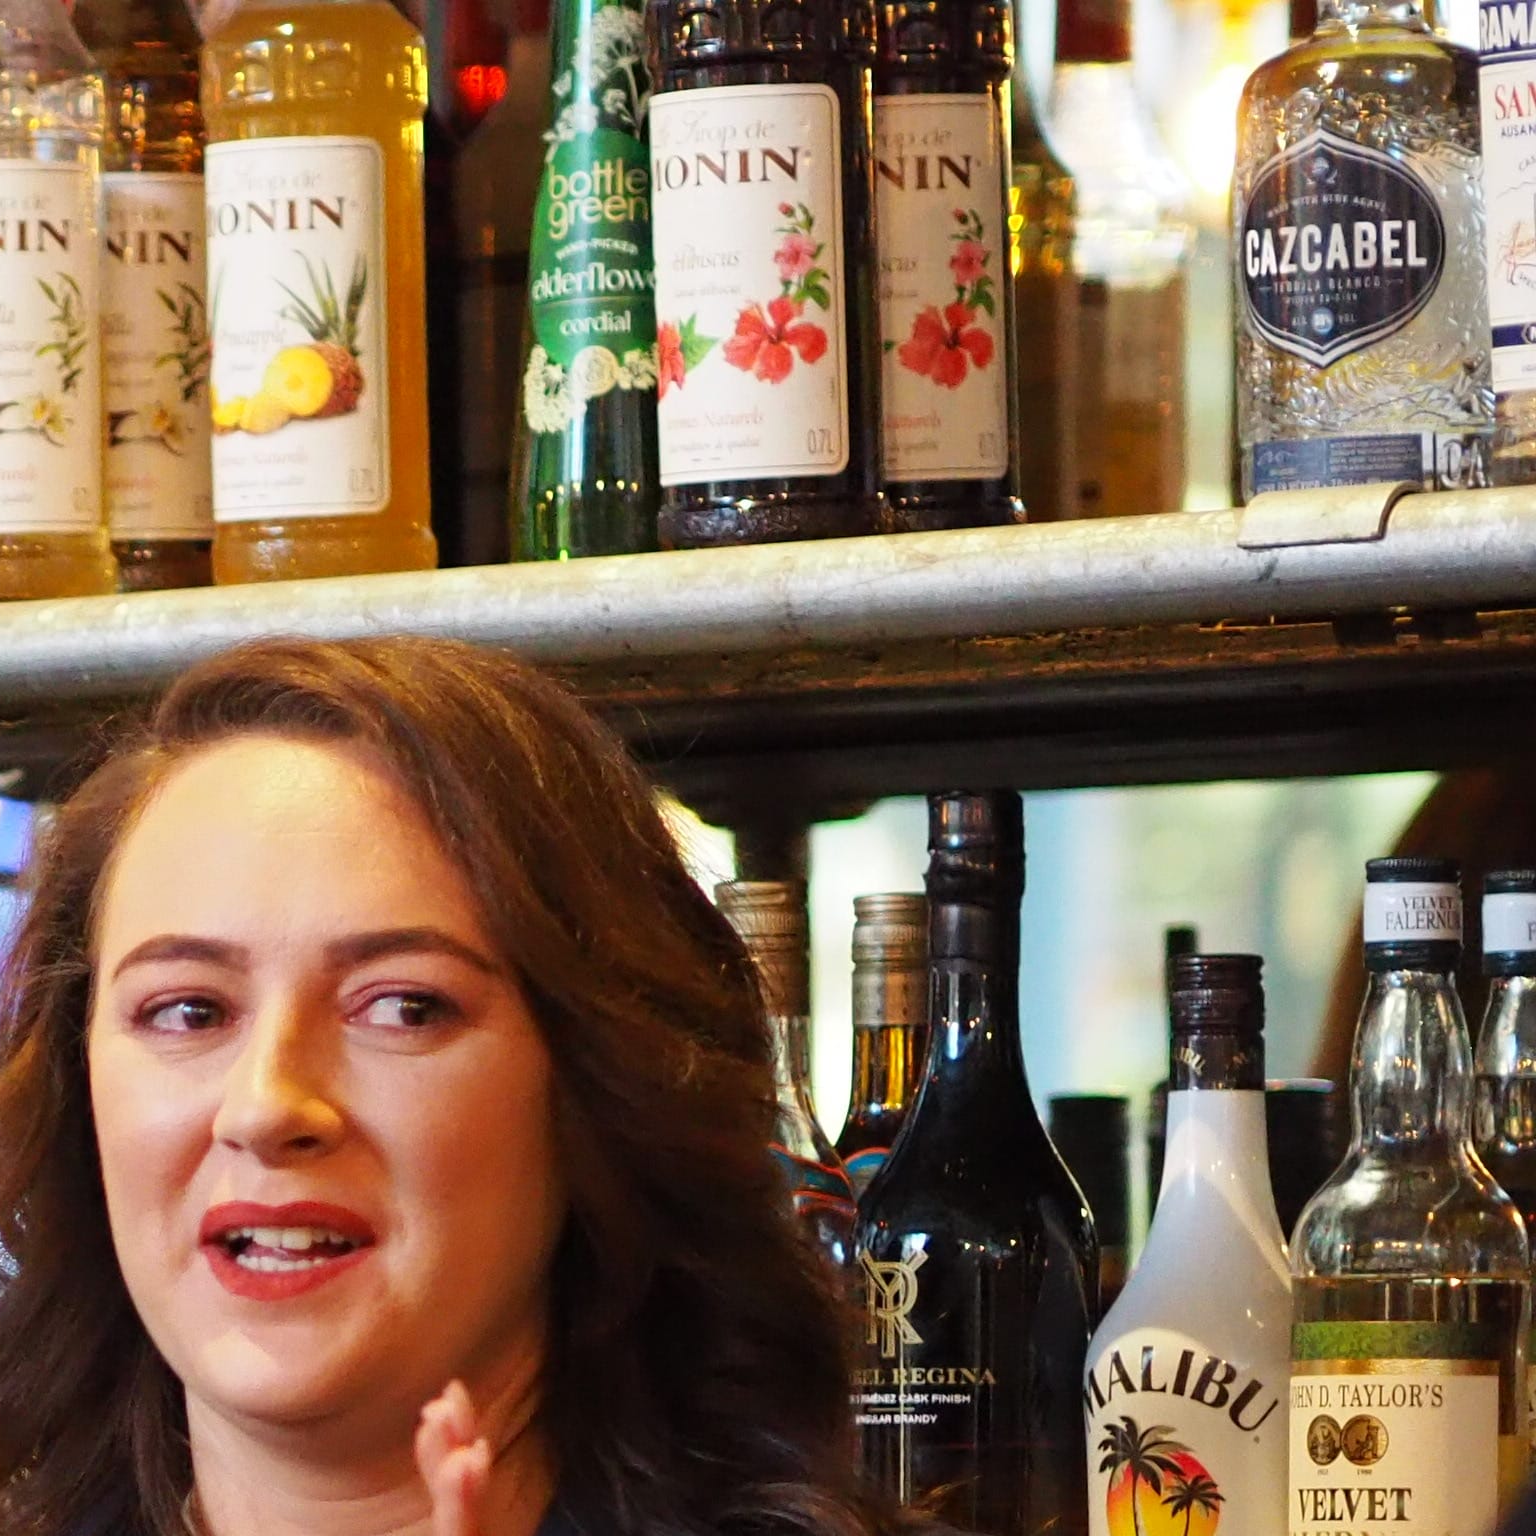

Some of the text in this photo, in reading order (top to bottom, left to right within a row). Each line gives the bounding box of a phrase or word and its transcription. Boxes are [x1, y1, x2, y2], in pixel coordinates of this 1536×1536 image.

[549, 158, 649, 200] bottle
[878, 154, 972, 191] NIN
[548, 196, 649, 240] green
[107, 230, 192, 265] NIN
[1246, 220, 1427, 278] CAZCABEL
[1328, 275, 1380, 290] BLANCO
[560, 310, 632, 337] cordial
[1401, 896, 1456, 911] VELVET
[892, 1367, 997, 1386] REGINA
[1084, 1346, 1279, 1434] MALIBU
[899, 1394, 929, 1405] CASK
[931, 1394, 971, 1405] FINISH
[1319, 1385, 1332, 1408] D.
[1338, 1384, 1444, 1409] TAYLOR'S
[894, 1413, 937, 1425] BRANDY
[1298, 1487, 1413, 1522] VELVET
